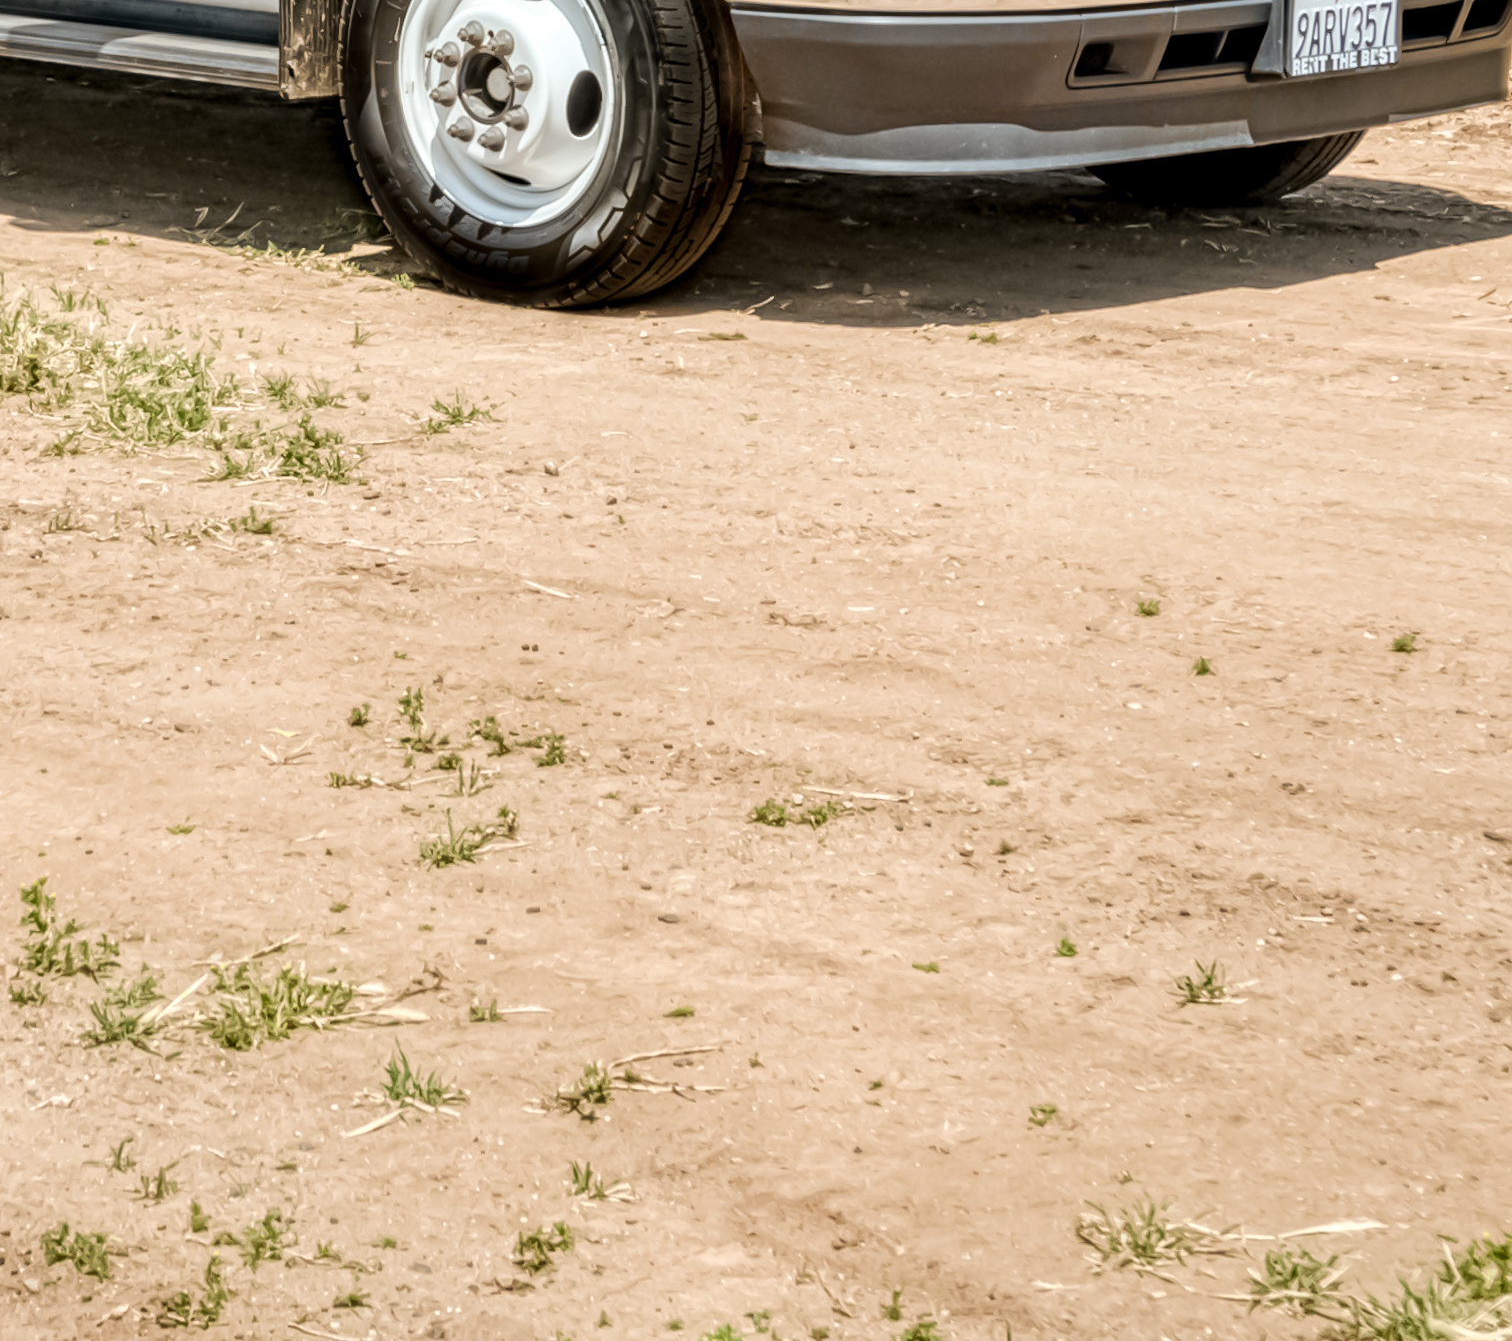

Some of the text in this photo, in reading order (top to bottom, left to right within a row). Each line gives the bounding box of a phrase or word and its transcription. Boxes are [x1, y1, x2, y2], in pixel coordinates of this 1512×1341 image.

[1296, 2, 1393, 58] 9ARV357
[1292, 47, 1397, 77] RENT THE BEST
